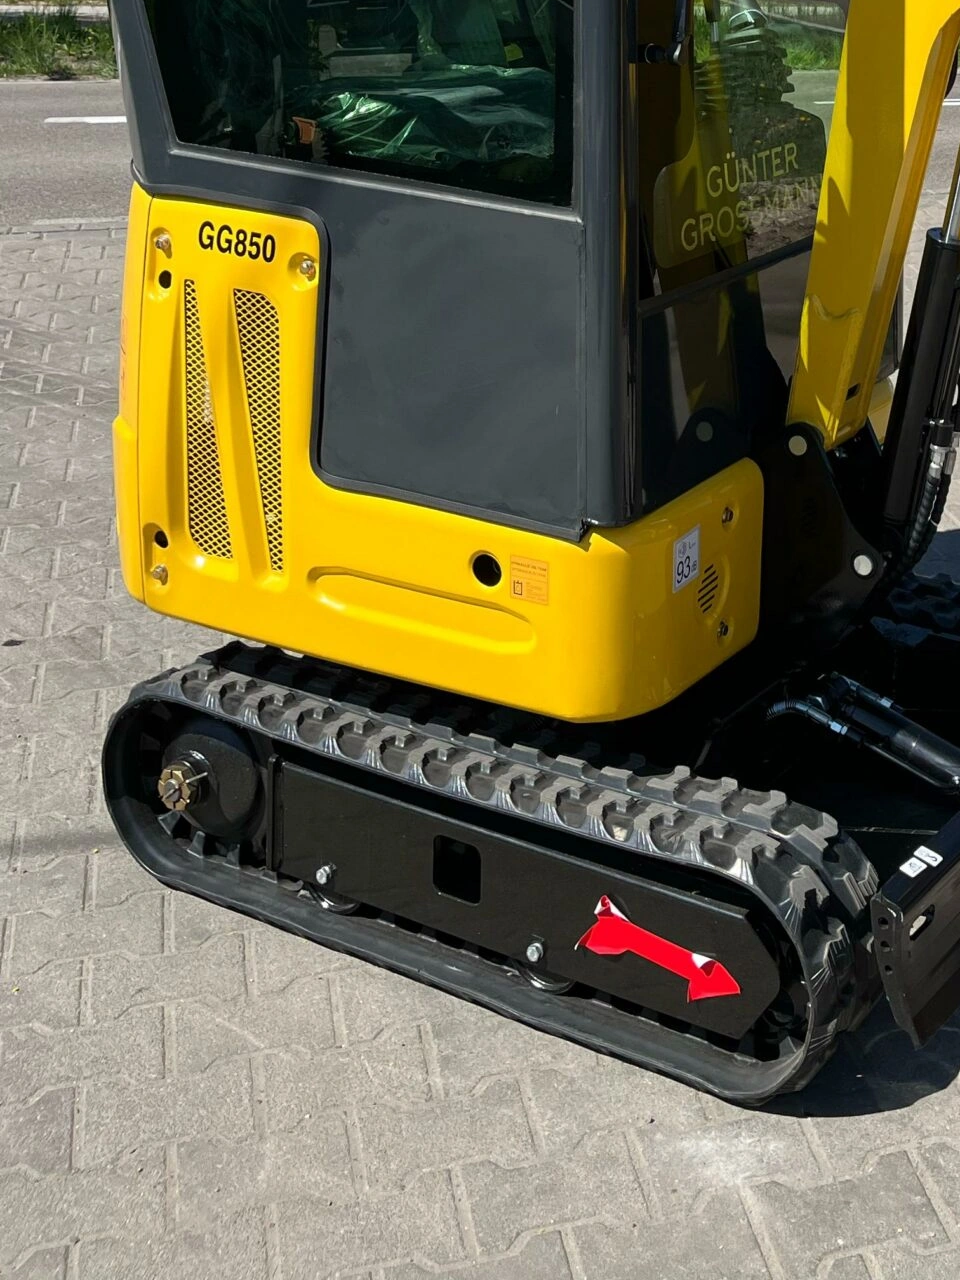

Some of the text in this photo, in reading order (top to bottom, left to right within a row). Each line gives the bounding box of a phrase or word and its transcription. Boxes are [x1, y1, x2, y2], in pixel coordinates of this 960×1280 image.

[706, 142, 798, 197] GÜNTER
[199, 220, 276, 263] GG850
[676, 555, 691, 584] 93
